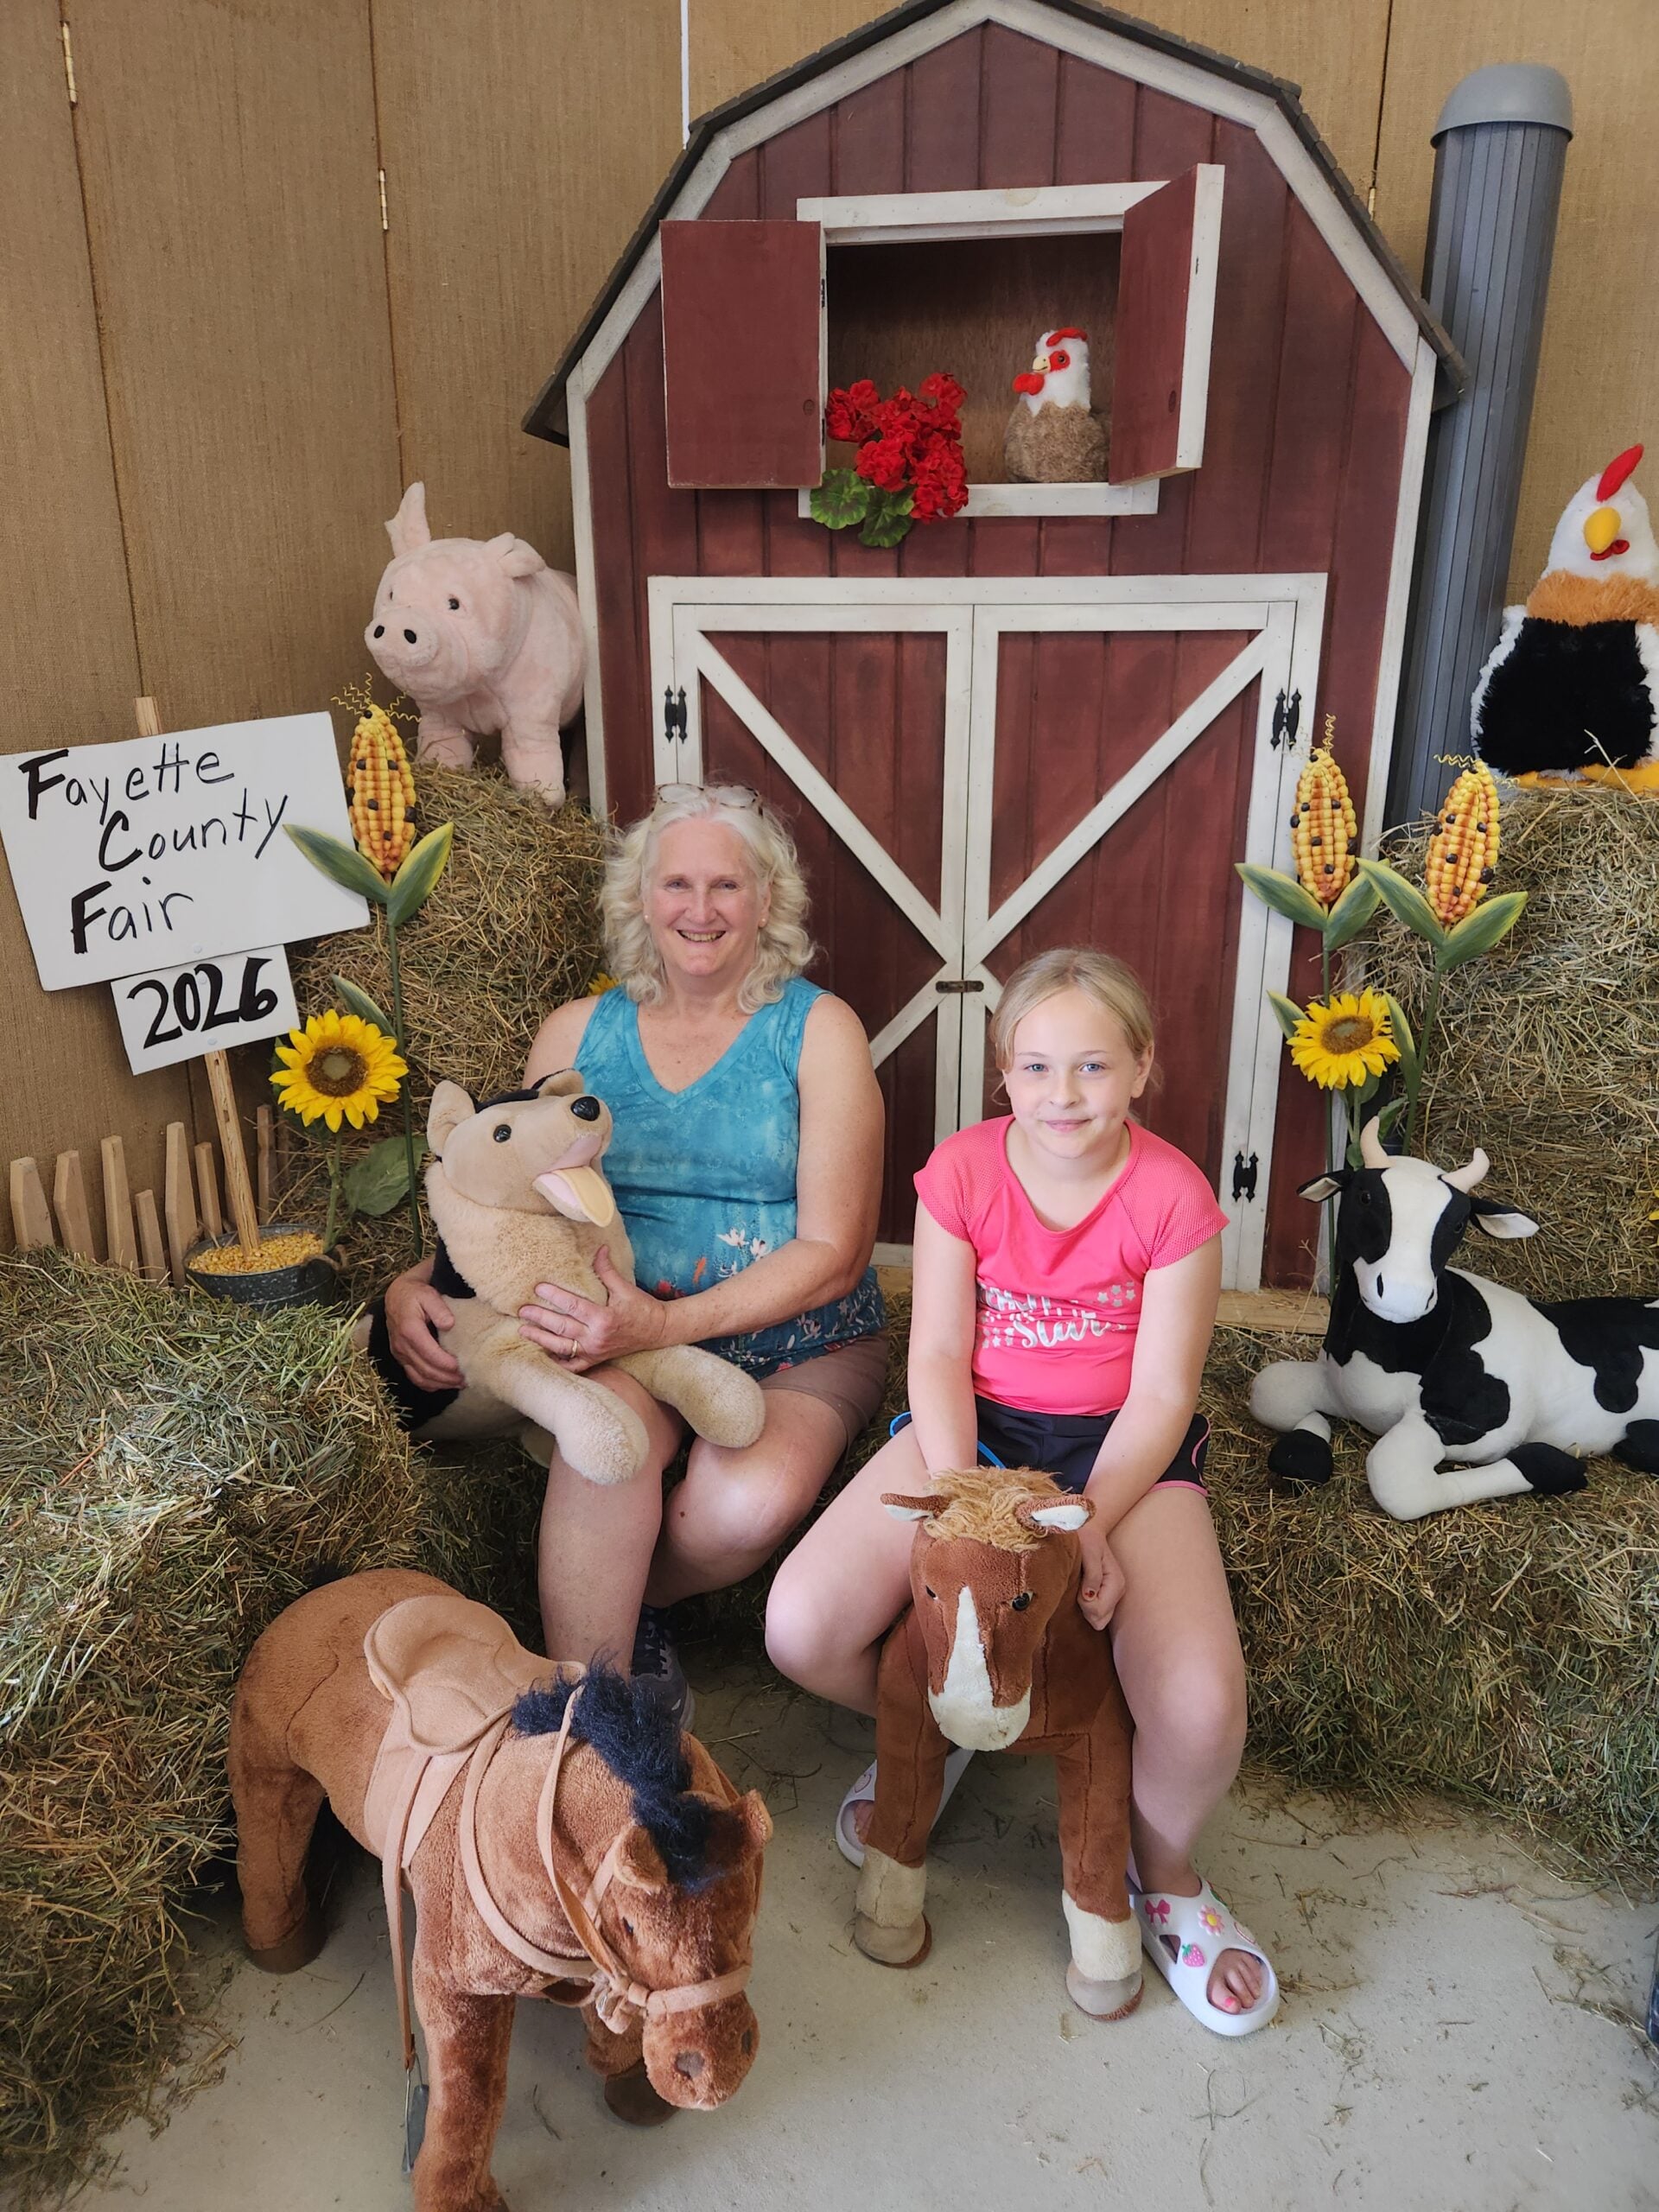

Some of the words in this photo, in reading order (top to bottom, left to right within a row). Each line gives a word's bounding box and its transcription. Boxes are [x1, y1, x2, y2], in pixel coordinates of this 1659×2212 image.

[18, 742, 235, 825] Fayette
[99, 787, 288, 872] County
[71, 876, 194, 954] Fair
[127, 957, 278, 1049] 2026
